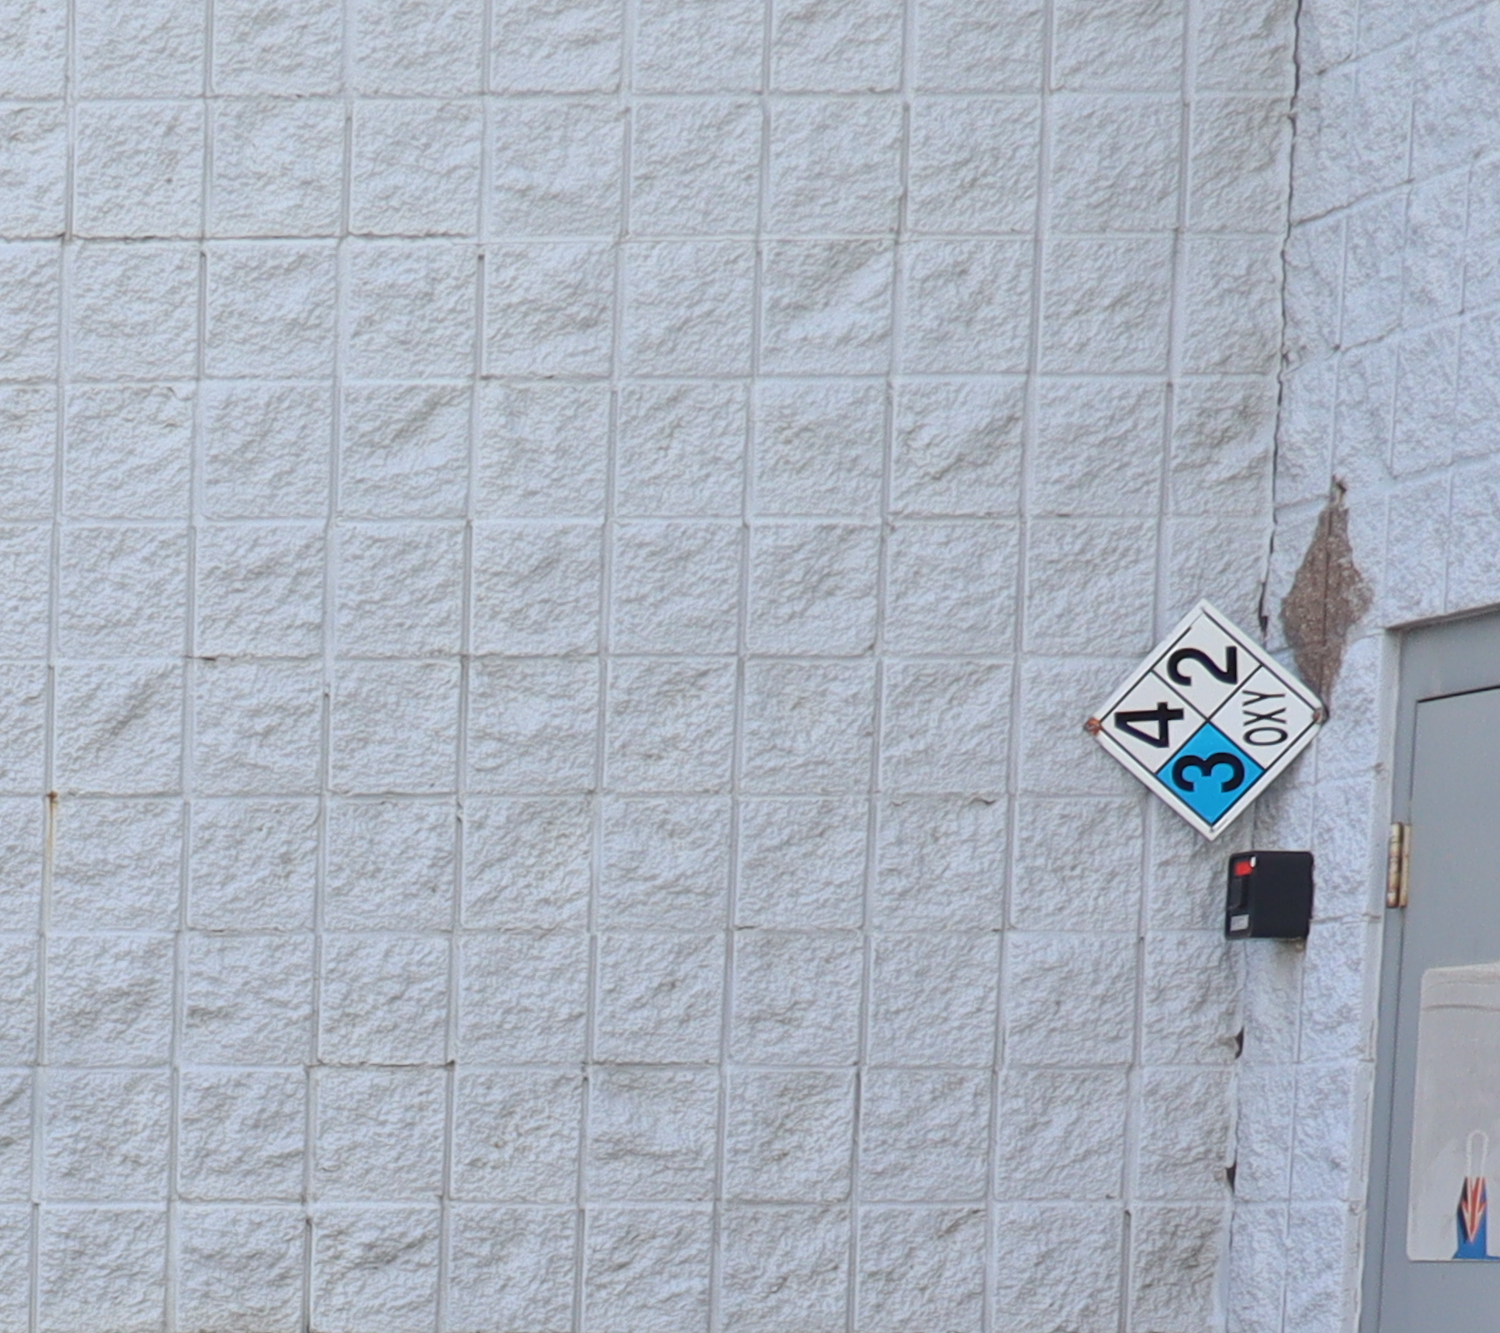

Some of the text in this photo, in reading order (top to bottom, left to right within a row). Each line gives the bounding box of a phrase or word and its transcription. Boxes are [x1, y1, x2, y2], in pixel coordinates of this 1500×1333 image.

[1166, 646, 1238, 686] 2
[1114, 702, 1184, 748] 4
[1242, 690, 1288, 746] OXY
[1172, 752, 1245, 793] 3
